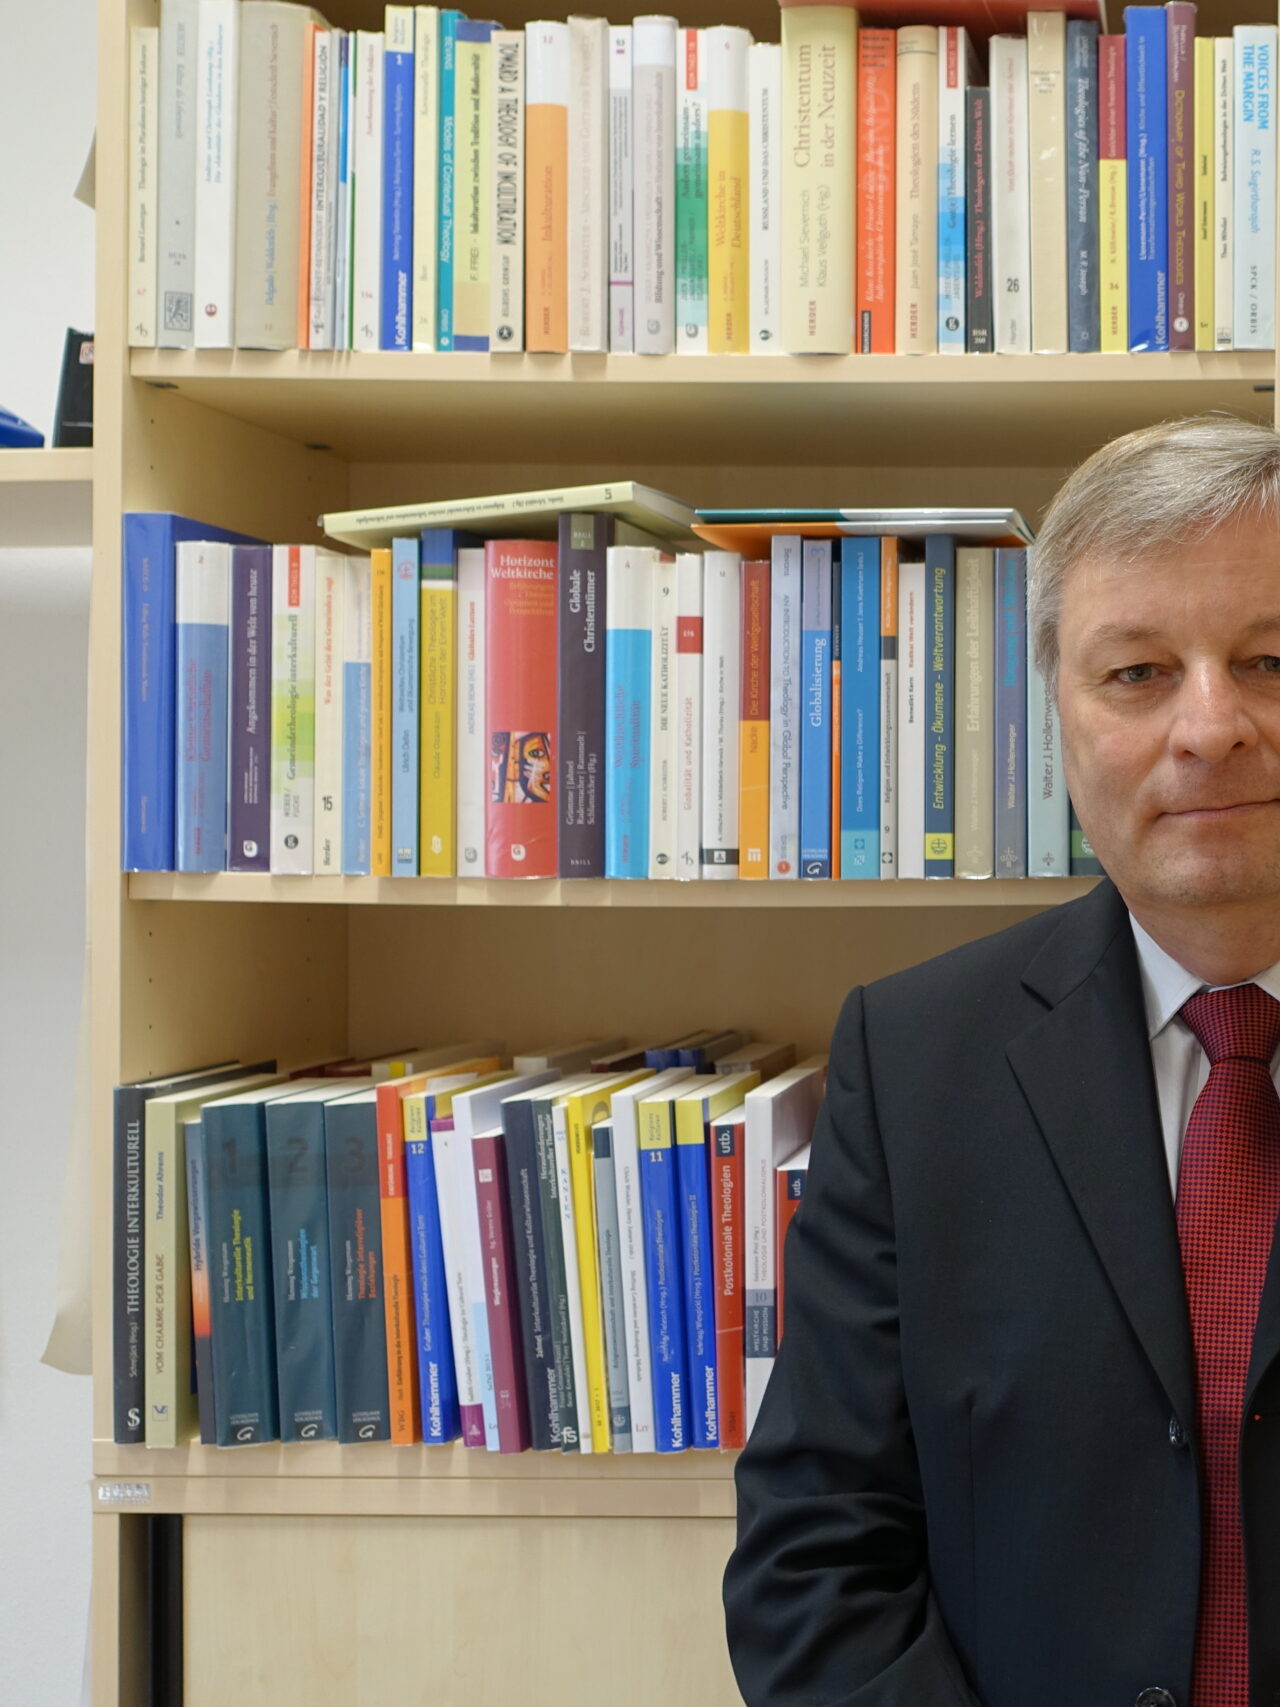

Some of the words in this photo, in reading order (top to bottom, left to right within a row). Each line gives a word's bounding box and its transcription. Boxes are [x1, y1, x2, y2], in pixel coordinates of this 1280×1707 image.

[498, 43, 519, 82] TOWARD
[1242, 45, 1254, 70] THE
[1257, 45, 1270, 90] VOICES
[821, 46, 835, 118] Neuzeit
[1242, 74, 1254, 121] MARGIN
[498, 98, 519, 147] THEOLOGY
[794, 45, 811, 167] Christentum
[1257, 94, 1269, 129] FROM
[821, 124, 835, 149] der
[499, 152, 516, 166] OF
[821, 153, 834, 167] in
[395, 270, 408, 345] Kohlhammer
[808, 301, 816, 335] HERDER
[910, 303, 918, 339] HERDER
[1155, 271, 1166, 344] Kohlhammer
[491, 567, 553, 580] Weltkirche
[500, 555, 554, 567] Horizont
[246, 569, 257, 596] heute
[429, 595, 436, 608] im
[569, 569, 582, 613] Globale
[966, 559, 980, 637] Leibhaftigkeit
[248, 599, 257, 614] von
[438, 598, 447, 618] Welt
[583, 570, 596, 652] Christentümer
[931, 568, 946, 671] Weltverantwortung
[246, 616, 257, 637] Welt
[428, 612, 439, 652] Theologie
[438, 621, 447, 645] Einen
[246, 639, 256, 655] der
[247, 657, 257, 666] in
[286, 614, 298, 682] interkulturell
[438, 648, 447, 662] der
[967, 640, 979, 658] der
[428, 656, 437, 704] Christliche
[438, 665, 447, 704] Horizont
[810, 638, 827, 727] Globalisierung
[967, 661, 981, 731] Erfahrungen
[246, 669, 258, 734] Angekommen
[930, 682, 945, 733] Ökumene
[286, 685, 299, 780] Gemeindetheologie
[932, 745, 947, 809] Entwicklung
[1043, 765, 1053, 799] Walter
[719, 1130, 731, 1153] utb.
[126, 1120, 139, 1233] INTERKULTURELL
[156, 1152, 164, 1181] Ahrens
[156, 1185, 164, 1220] Theodor
[189, 1160, 201, 1235] Vergewisserungen
[720, 1165, 732, 1222] Theologien
[792, 1179, 801, 1196] utb.
[156, 1254, 164, 1282] GABE
[192, 1238, 203, 1271] Hybride
[721, 1225, 734, 1296] Postkoloniale
[127, 1237, 140, 1314] THEOLOGIE
[156, 1284, 164, 1303] DER
[156, 1307, 164, 1349] CHARME
[156, 1351, 164, 1374] VOM
[428, 1362, 441, 1437] Kohlhammer
[546, 1368, 560, 1443] Kohlhammer
[670, 1372, 683, 1447] Kohlhammer
[703, 1366, 716, 1441] Kohlhammer
